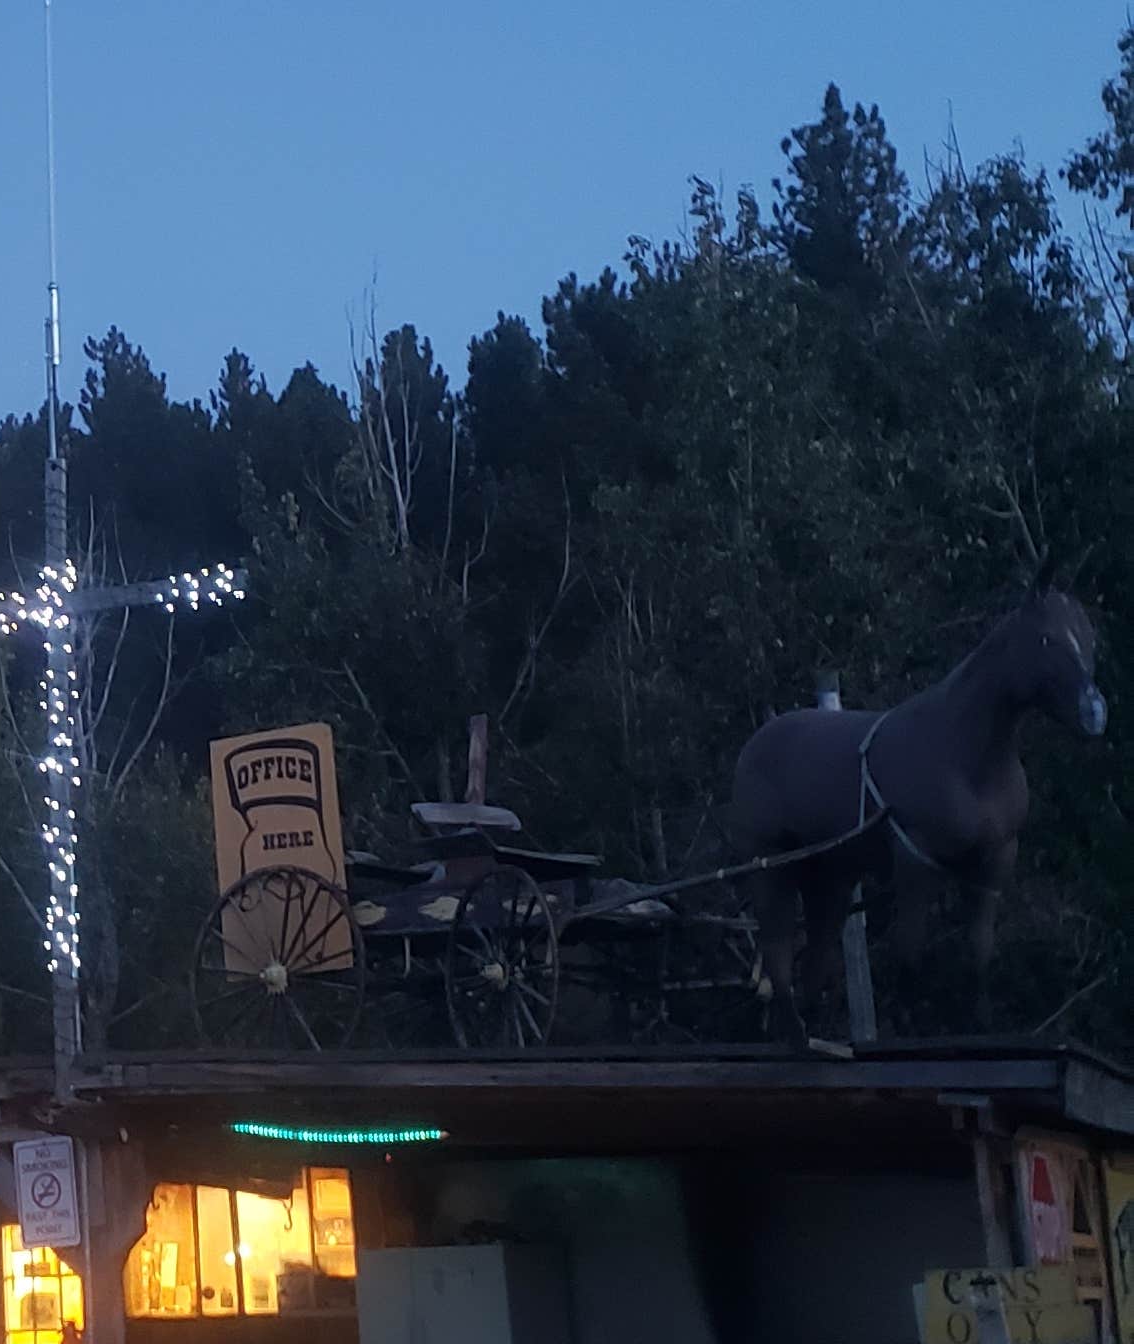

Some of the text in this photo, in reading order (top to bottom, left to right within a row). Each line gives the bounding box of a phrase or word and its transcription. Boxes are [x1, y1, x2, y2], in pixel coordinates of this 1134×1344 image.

[237, 755, 312, 789] OFFICE
[262, 829, 314, 850] HERE
[943, 1268, 1040, 1304] CNS
